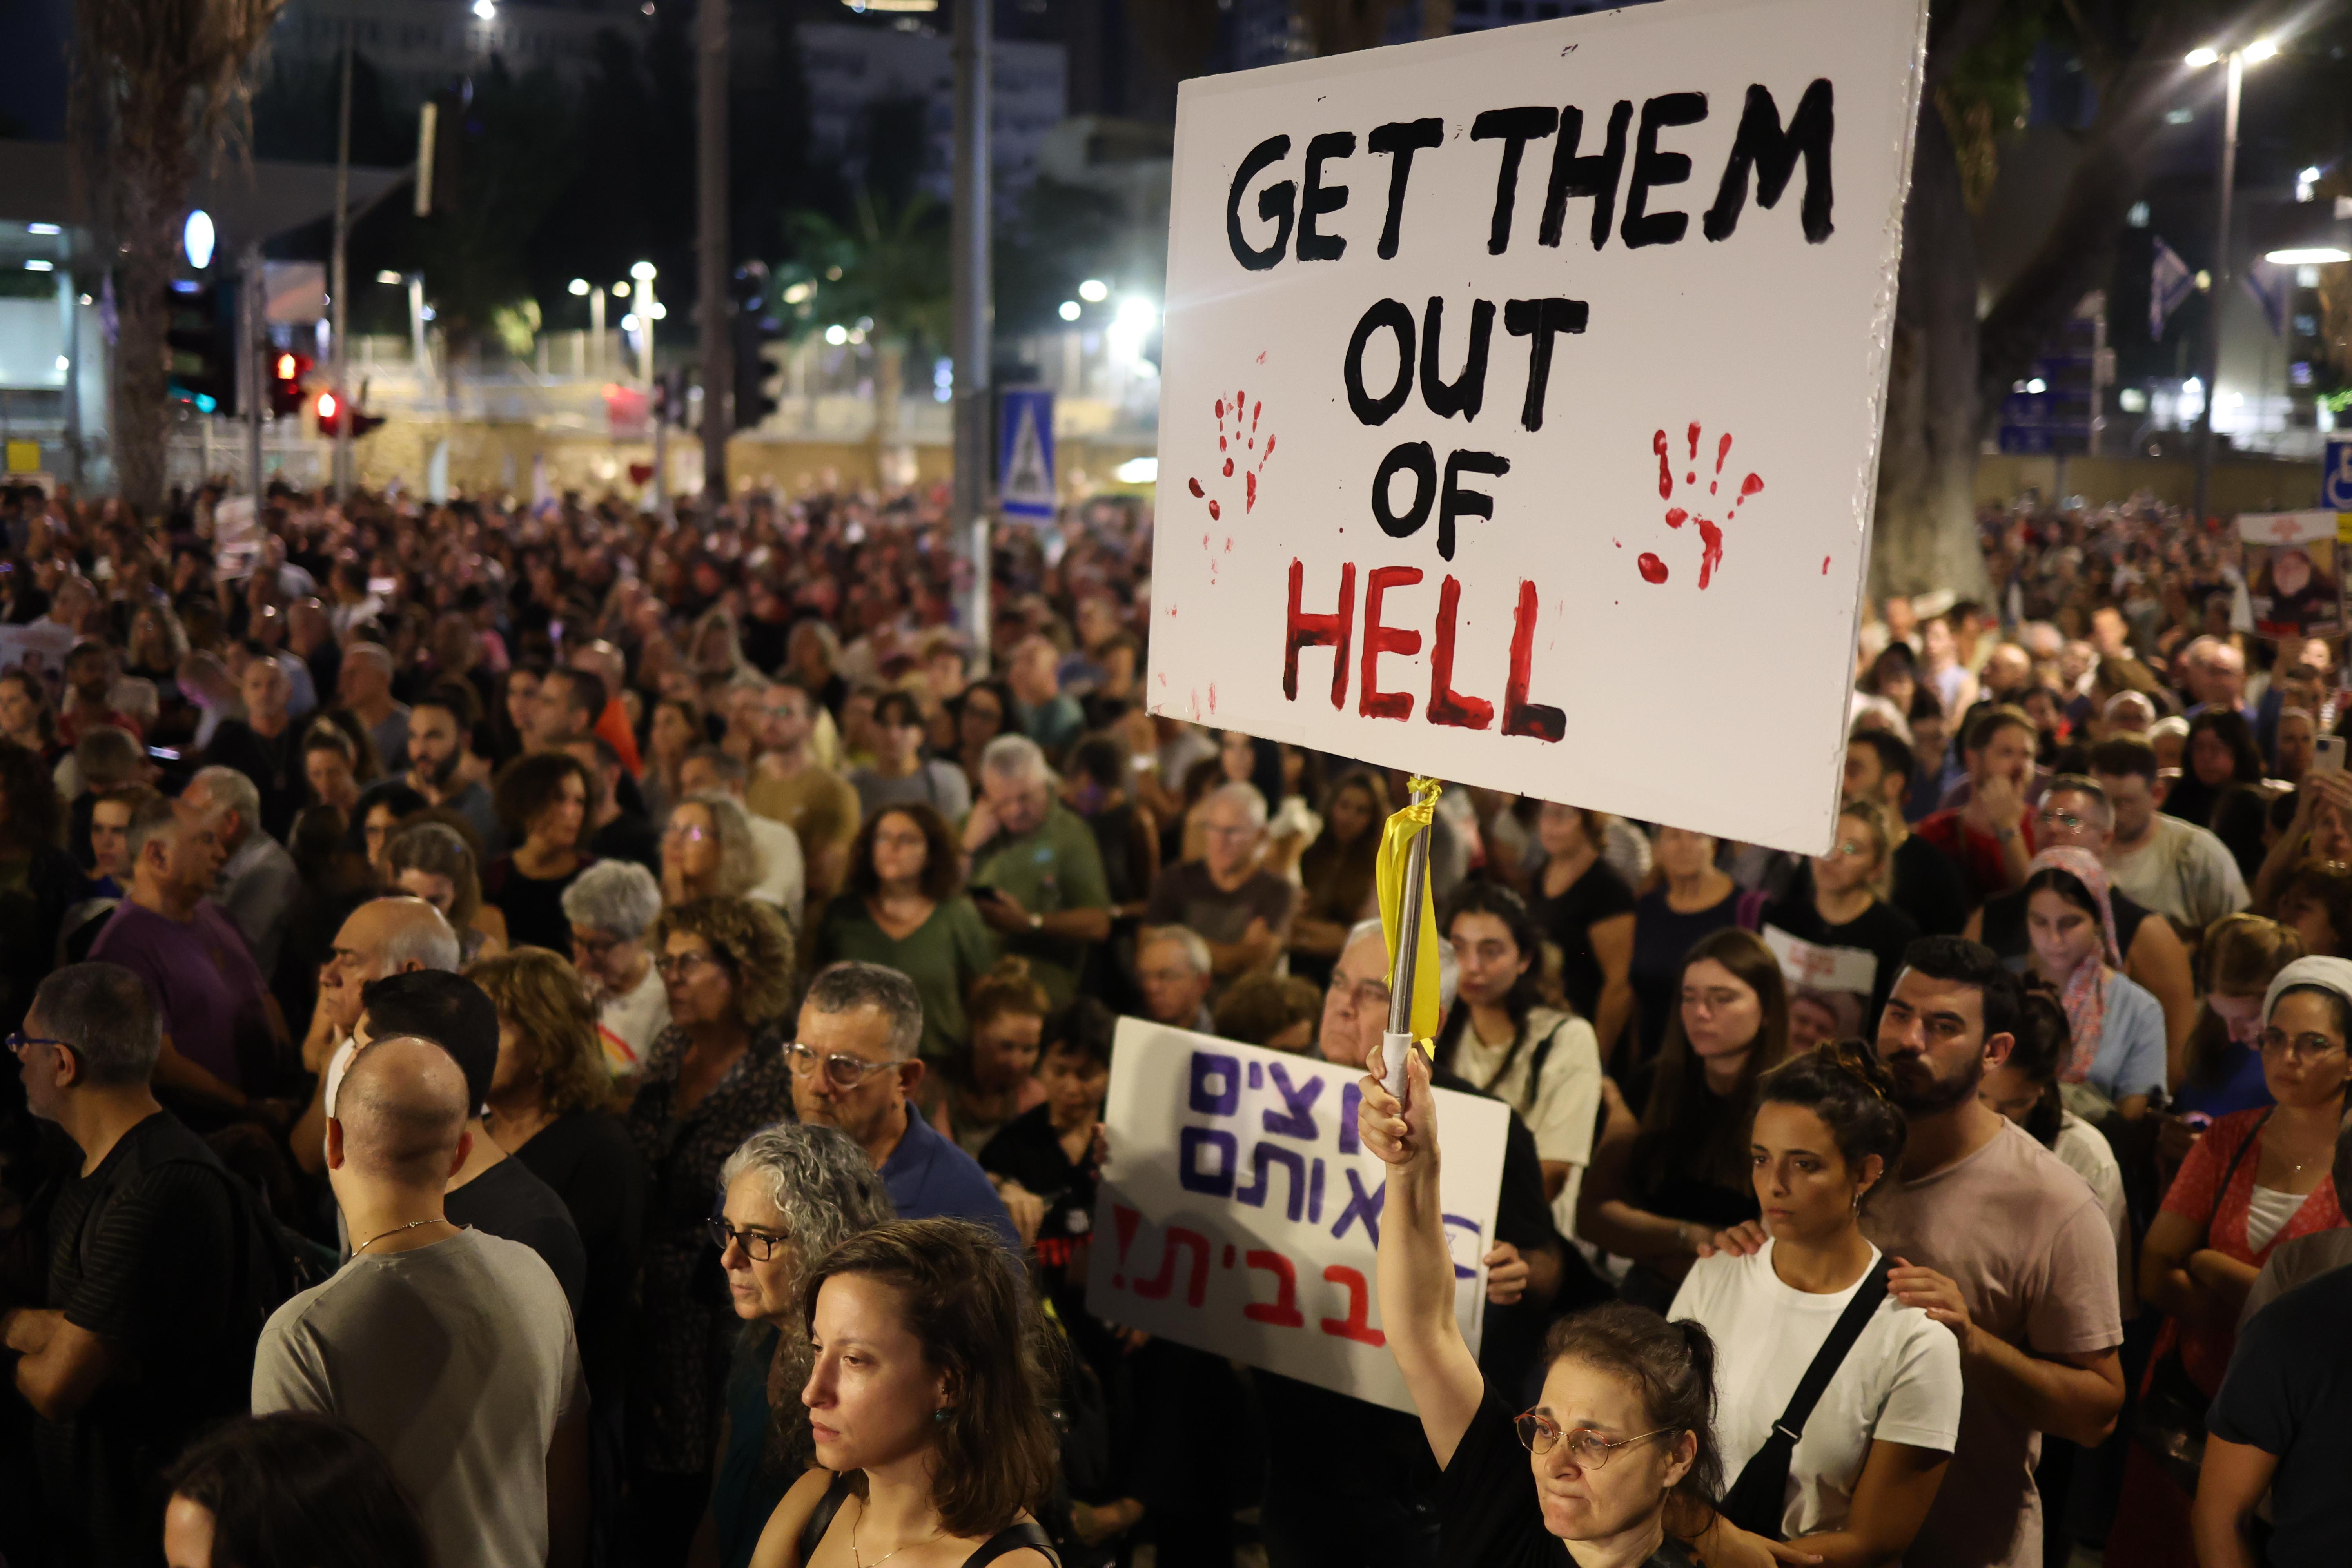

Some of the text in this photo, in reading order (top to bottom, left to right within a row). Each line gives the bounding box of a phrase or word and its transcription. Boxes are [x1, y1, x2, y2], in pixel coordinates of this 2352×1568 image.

[1226, 78, 1835, 271] GET THEM
[1343, 296, 1589, 433] OUT
[1371, 440, 1511, 563] OF
[1283, 556, 1567, 743] HELL
[1189, 1051, 1363, 1155] וצים
[1112, 1205, 1386, 1348] בבית!
